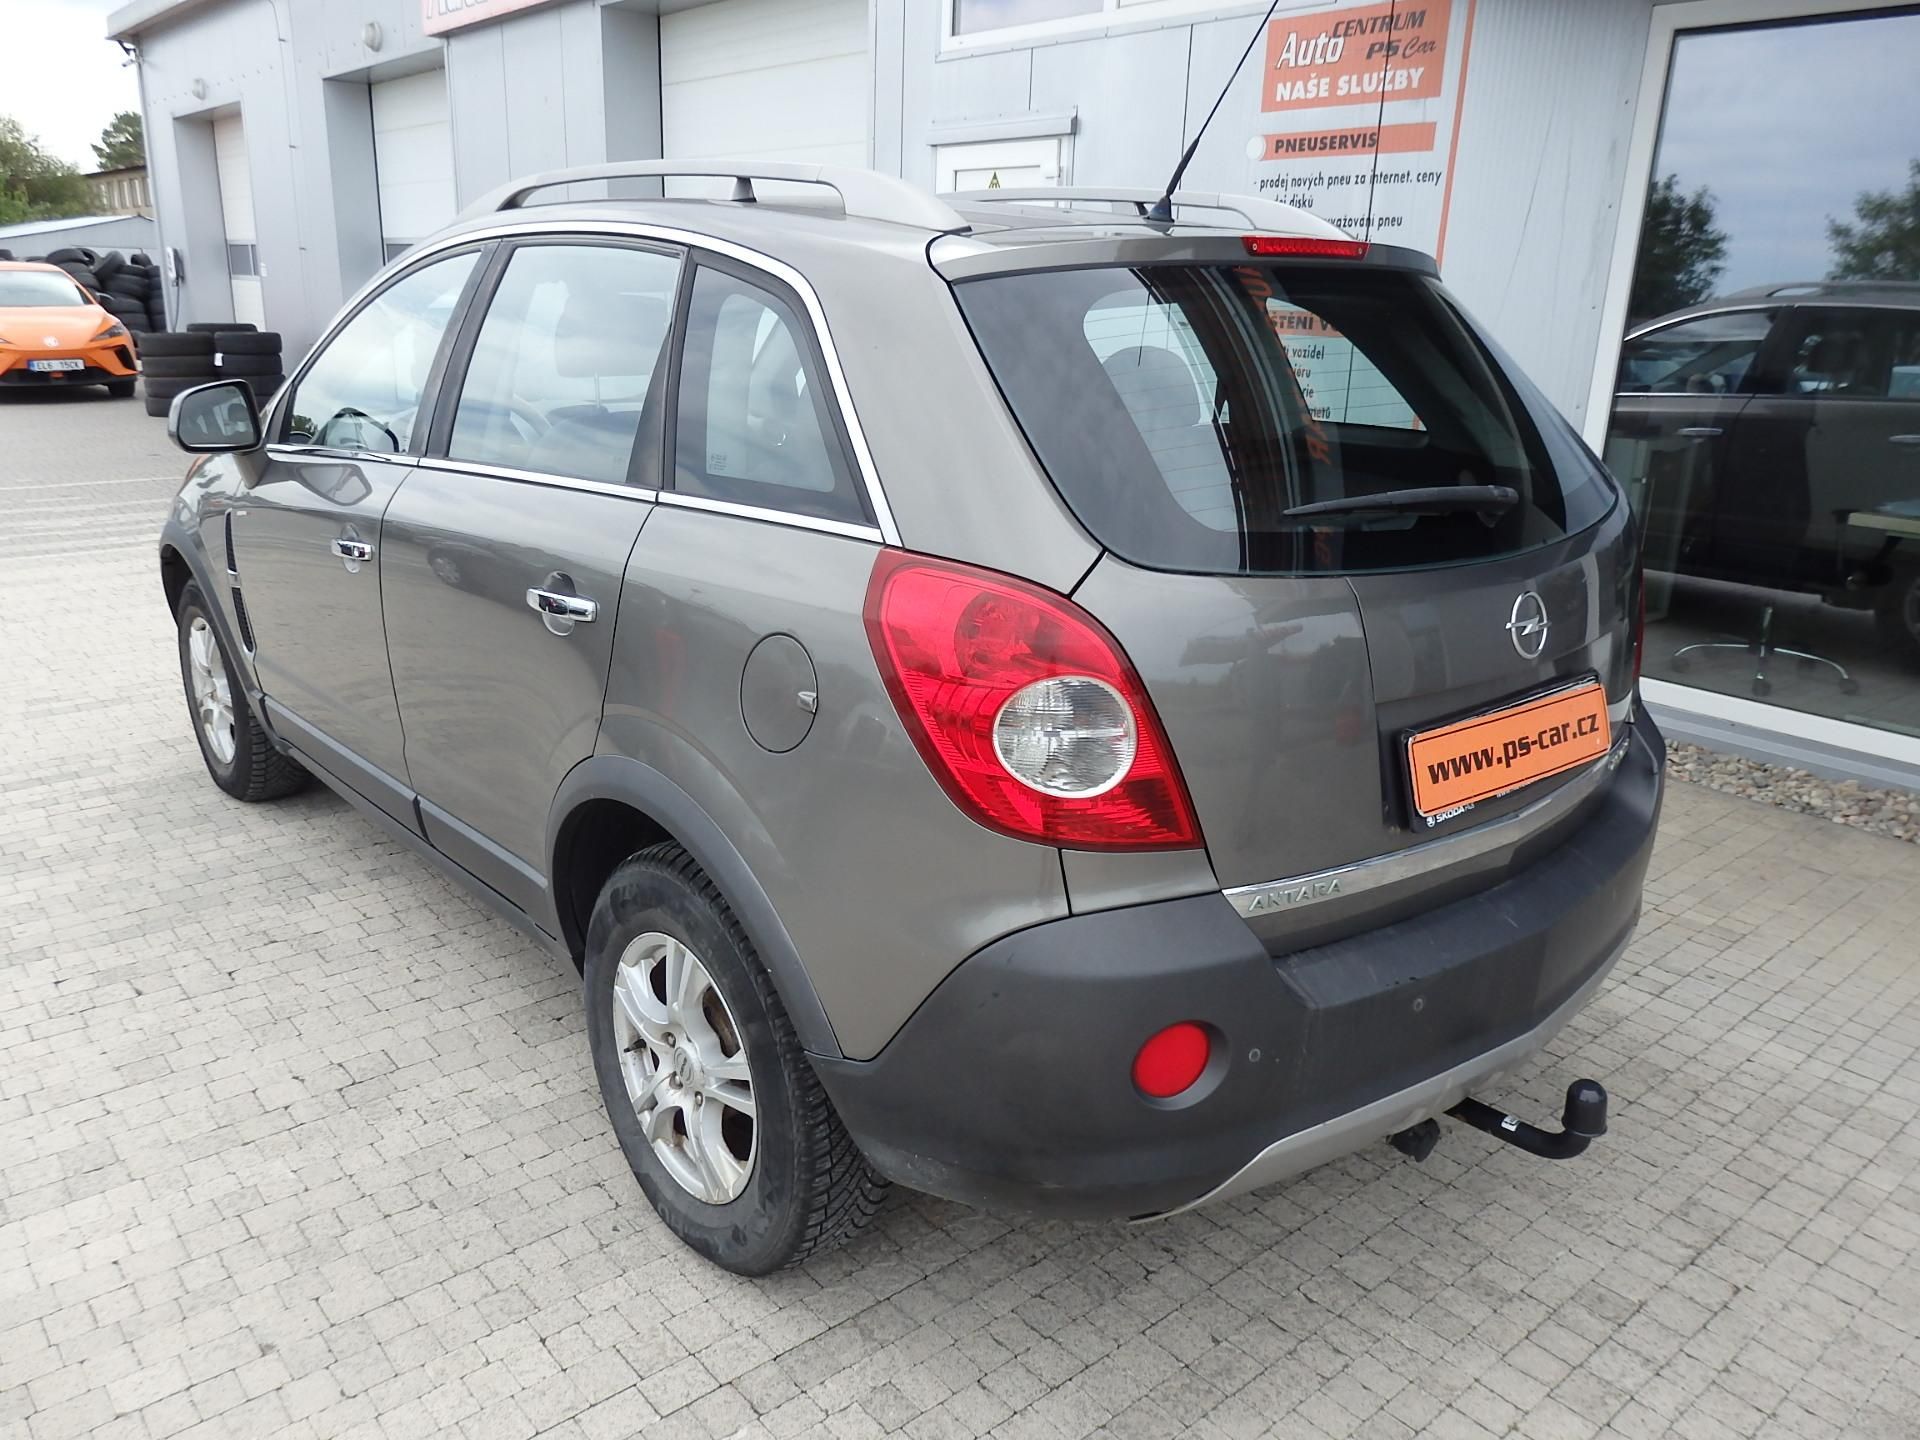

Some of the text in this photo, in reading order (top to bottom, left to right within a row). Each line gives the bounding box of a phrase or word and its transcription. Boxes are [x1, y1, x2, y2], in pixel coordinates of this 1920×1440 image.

[1332, 10, 1426, 38] CENTRUM
[1275, 31, 1345, 70] Auto
[1366, 36, 1437, 60] PS Car
[1275, 64, 1424, 102] NAŠE SLUŽBY
[1274, 132, 1378, 154] PNEUSERVIS
[1259, 172, 1289, 192] prodej
[1291, 170, 1324, 191] nových
[1327, 174, 1351, 190] pneu
[1354, 174, 1366, 185] za
[1369, 168, 1412, 185] internet.
[1416, 171, 1442, 186] ceny
[1377, 216, 1403, 231] pneu
[1292, 344, 1325, 360] vozidel
[1427, 713, 1599, 785] www.ps-car.cz
[1248, 878, 1343, 912] ANTARA
